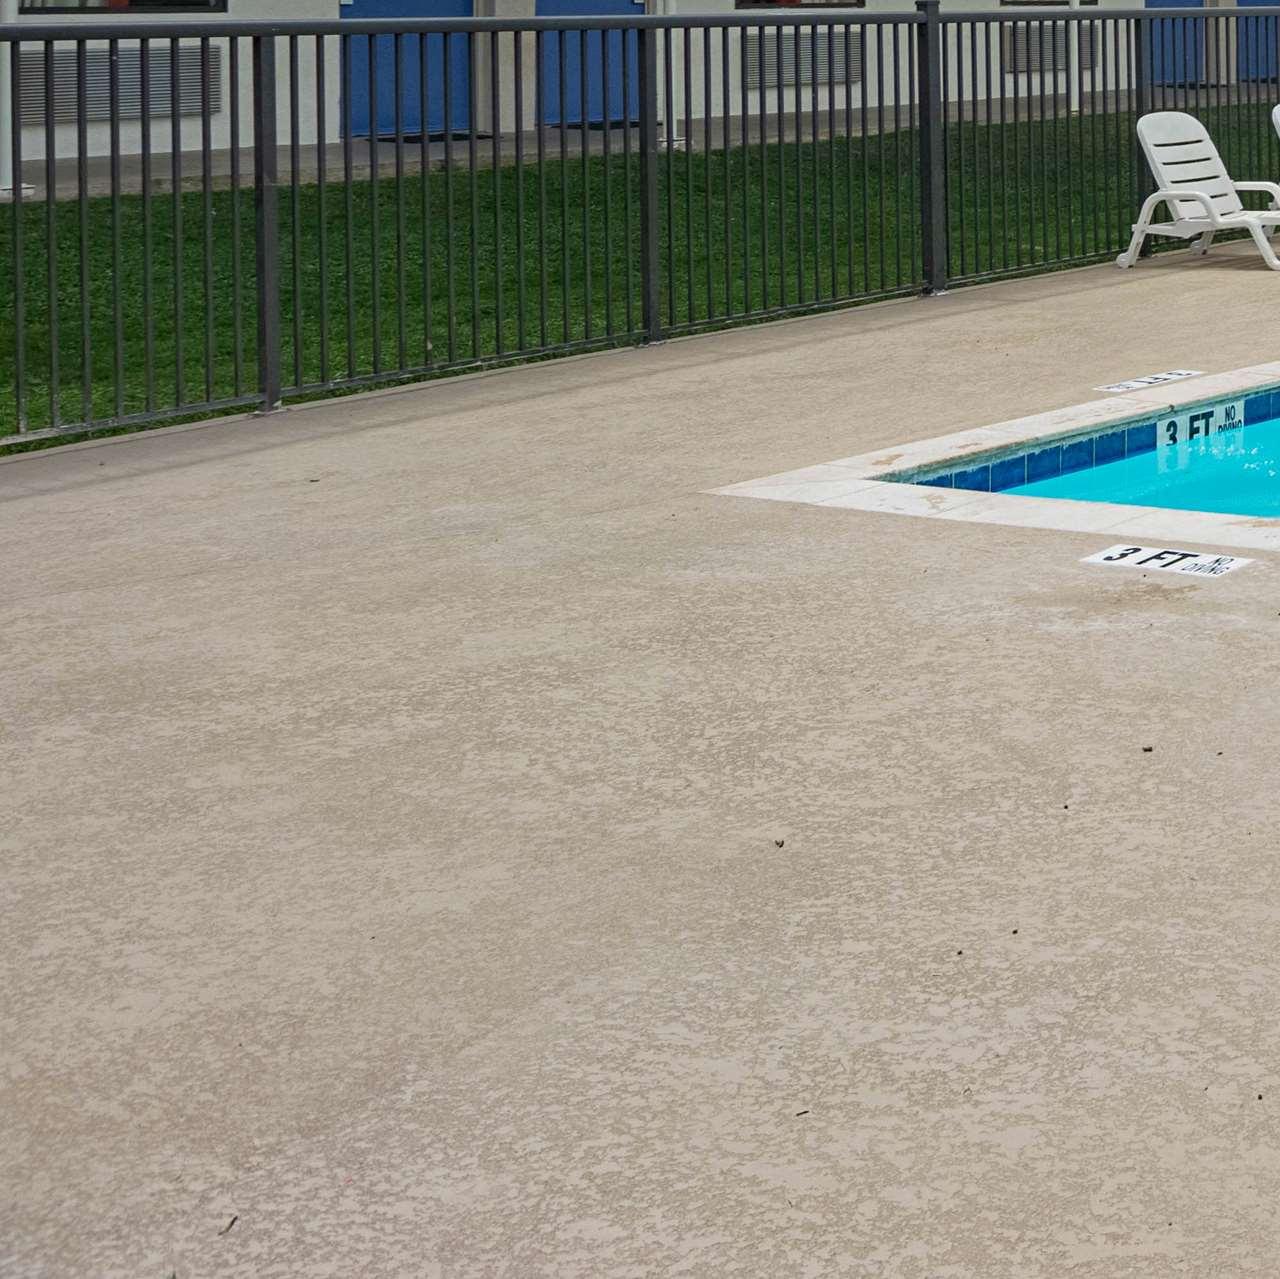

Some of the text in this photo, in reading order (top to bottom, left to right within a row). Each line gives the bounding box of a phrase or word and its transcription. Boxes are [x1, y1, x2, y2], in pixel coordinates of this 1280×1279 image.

[1225, 405, 1236, 422] NO
[1166, 411, 1215, 446] 3 FT
[1103, 547, 1200, 568] 3 FT
